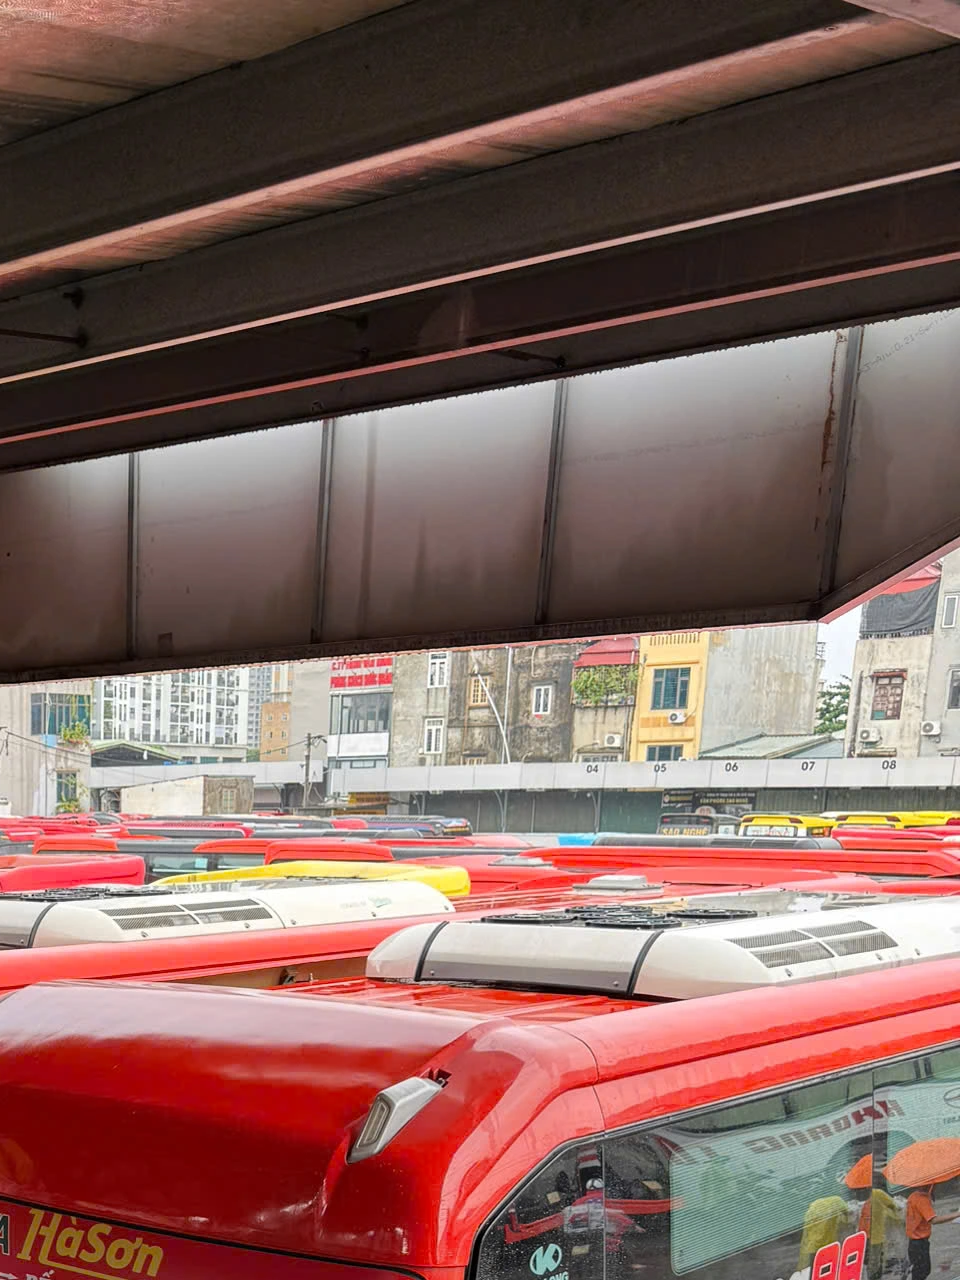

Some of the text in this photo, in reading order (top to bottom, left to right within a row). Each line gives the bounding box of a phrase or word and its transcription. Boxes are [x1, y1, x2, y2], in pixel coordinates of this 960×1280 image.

[586, 764, 599, 774] 04
[653, 763, 667, 773] 05
[724, 762, 739, 772] 06
[801, 761, 815, 771] 07
[882, 760, 896, 770] 08
